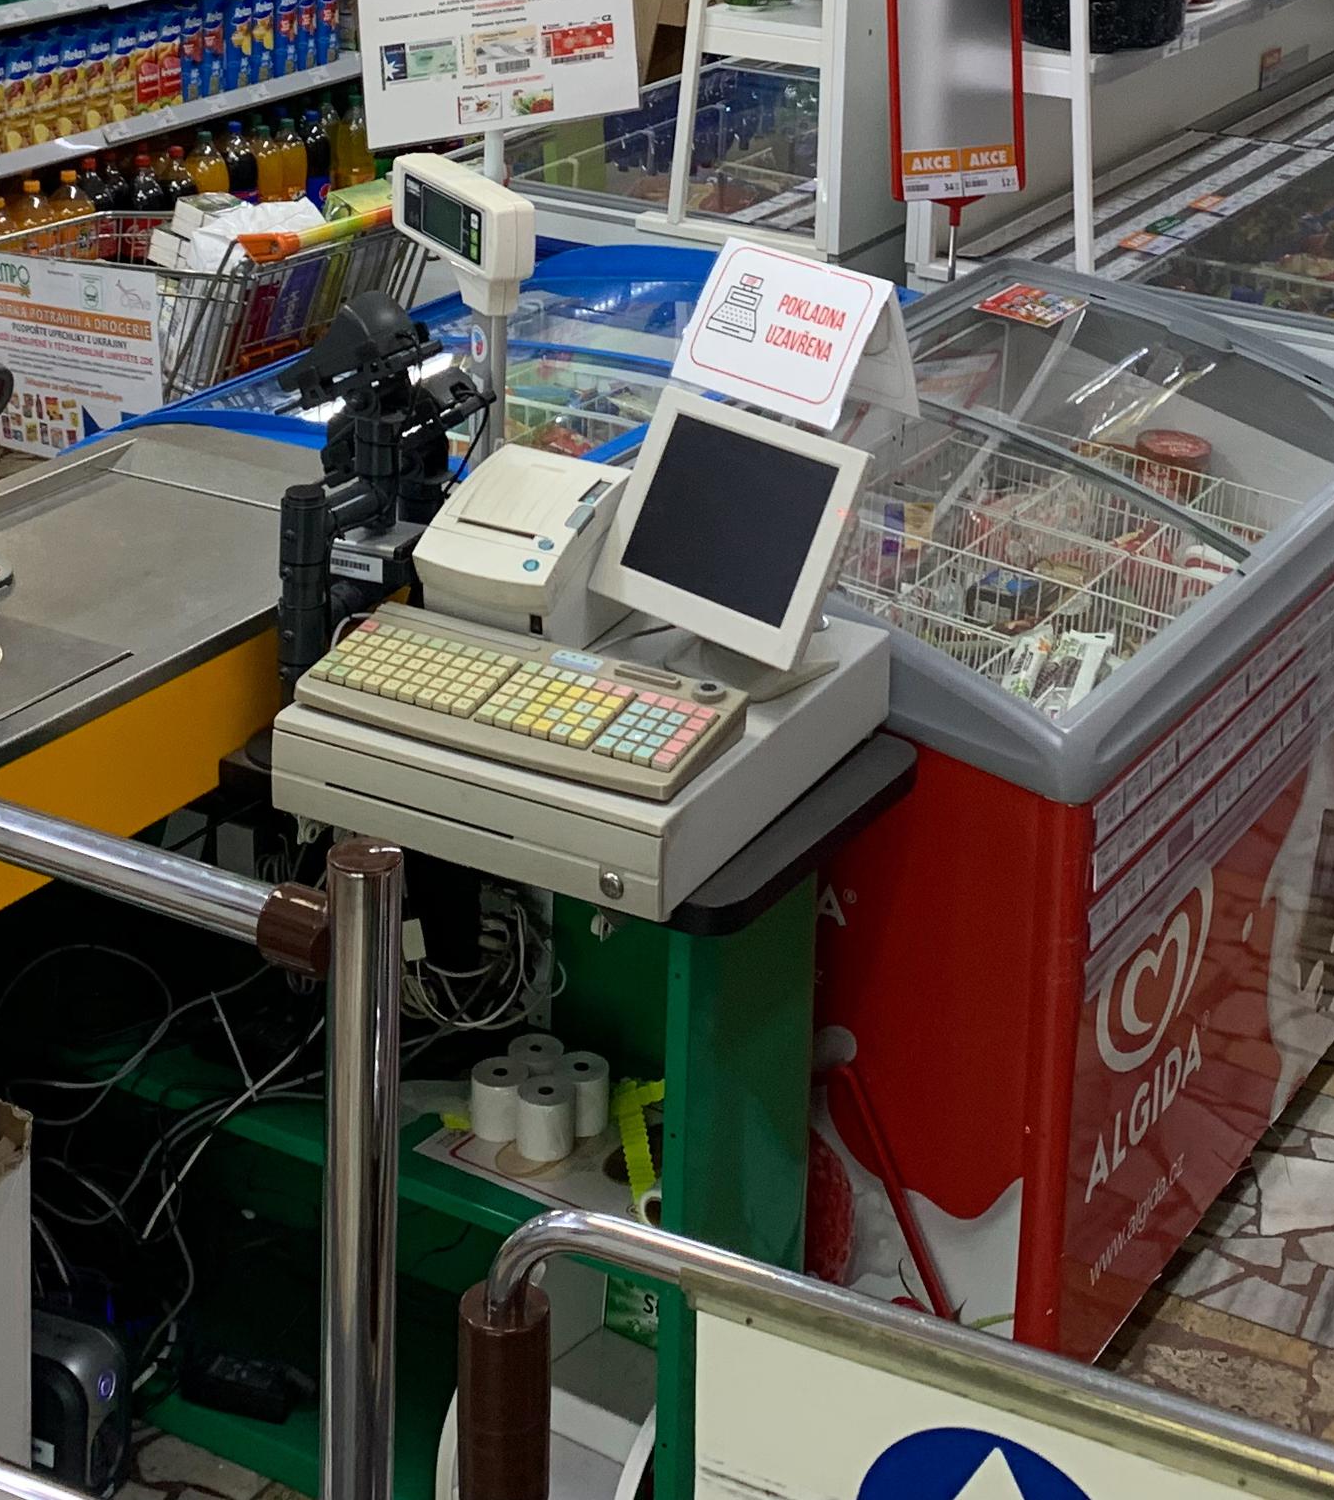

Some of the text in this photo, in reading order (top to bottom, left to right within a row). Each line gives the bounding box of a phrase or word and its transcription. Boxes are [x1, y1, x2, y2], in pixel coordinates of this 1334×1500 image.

[912, 155, 952, 171] AKCE
[970, 150, 1008, 167] AKCE
[94, 318, 151, 339] DROGERIE
[777, 293, 847, 332] POKLADNA
[765, 323, 833, 362] UZAVŘENA
[1084, 1023, 1204, 1204] ALGIDA
[1089, 1152, 1186, 1287] www.algida.cz
